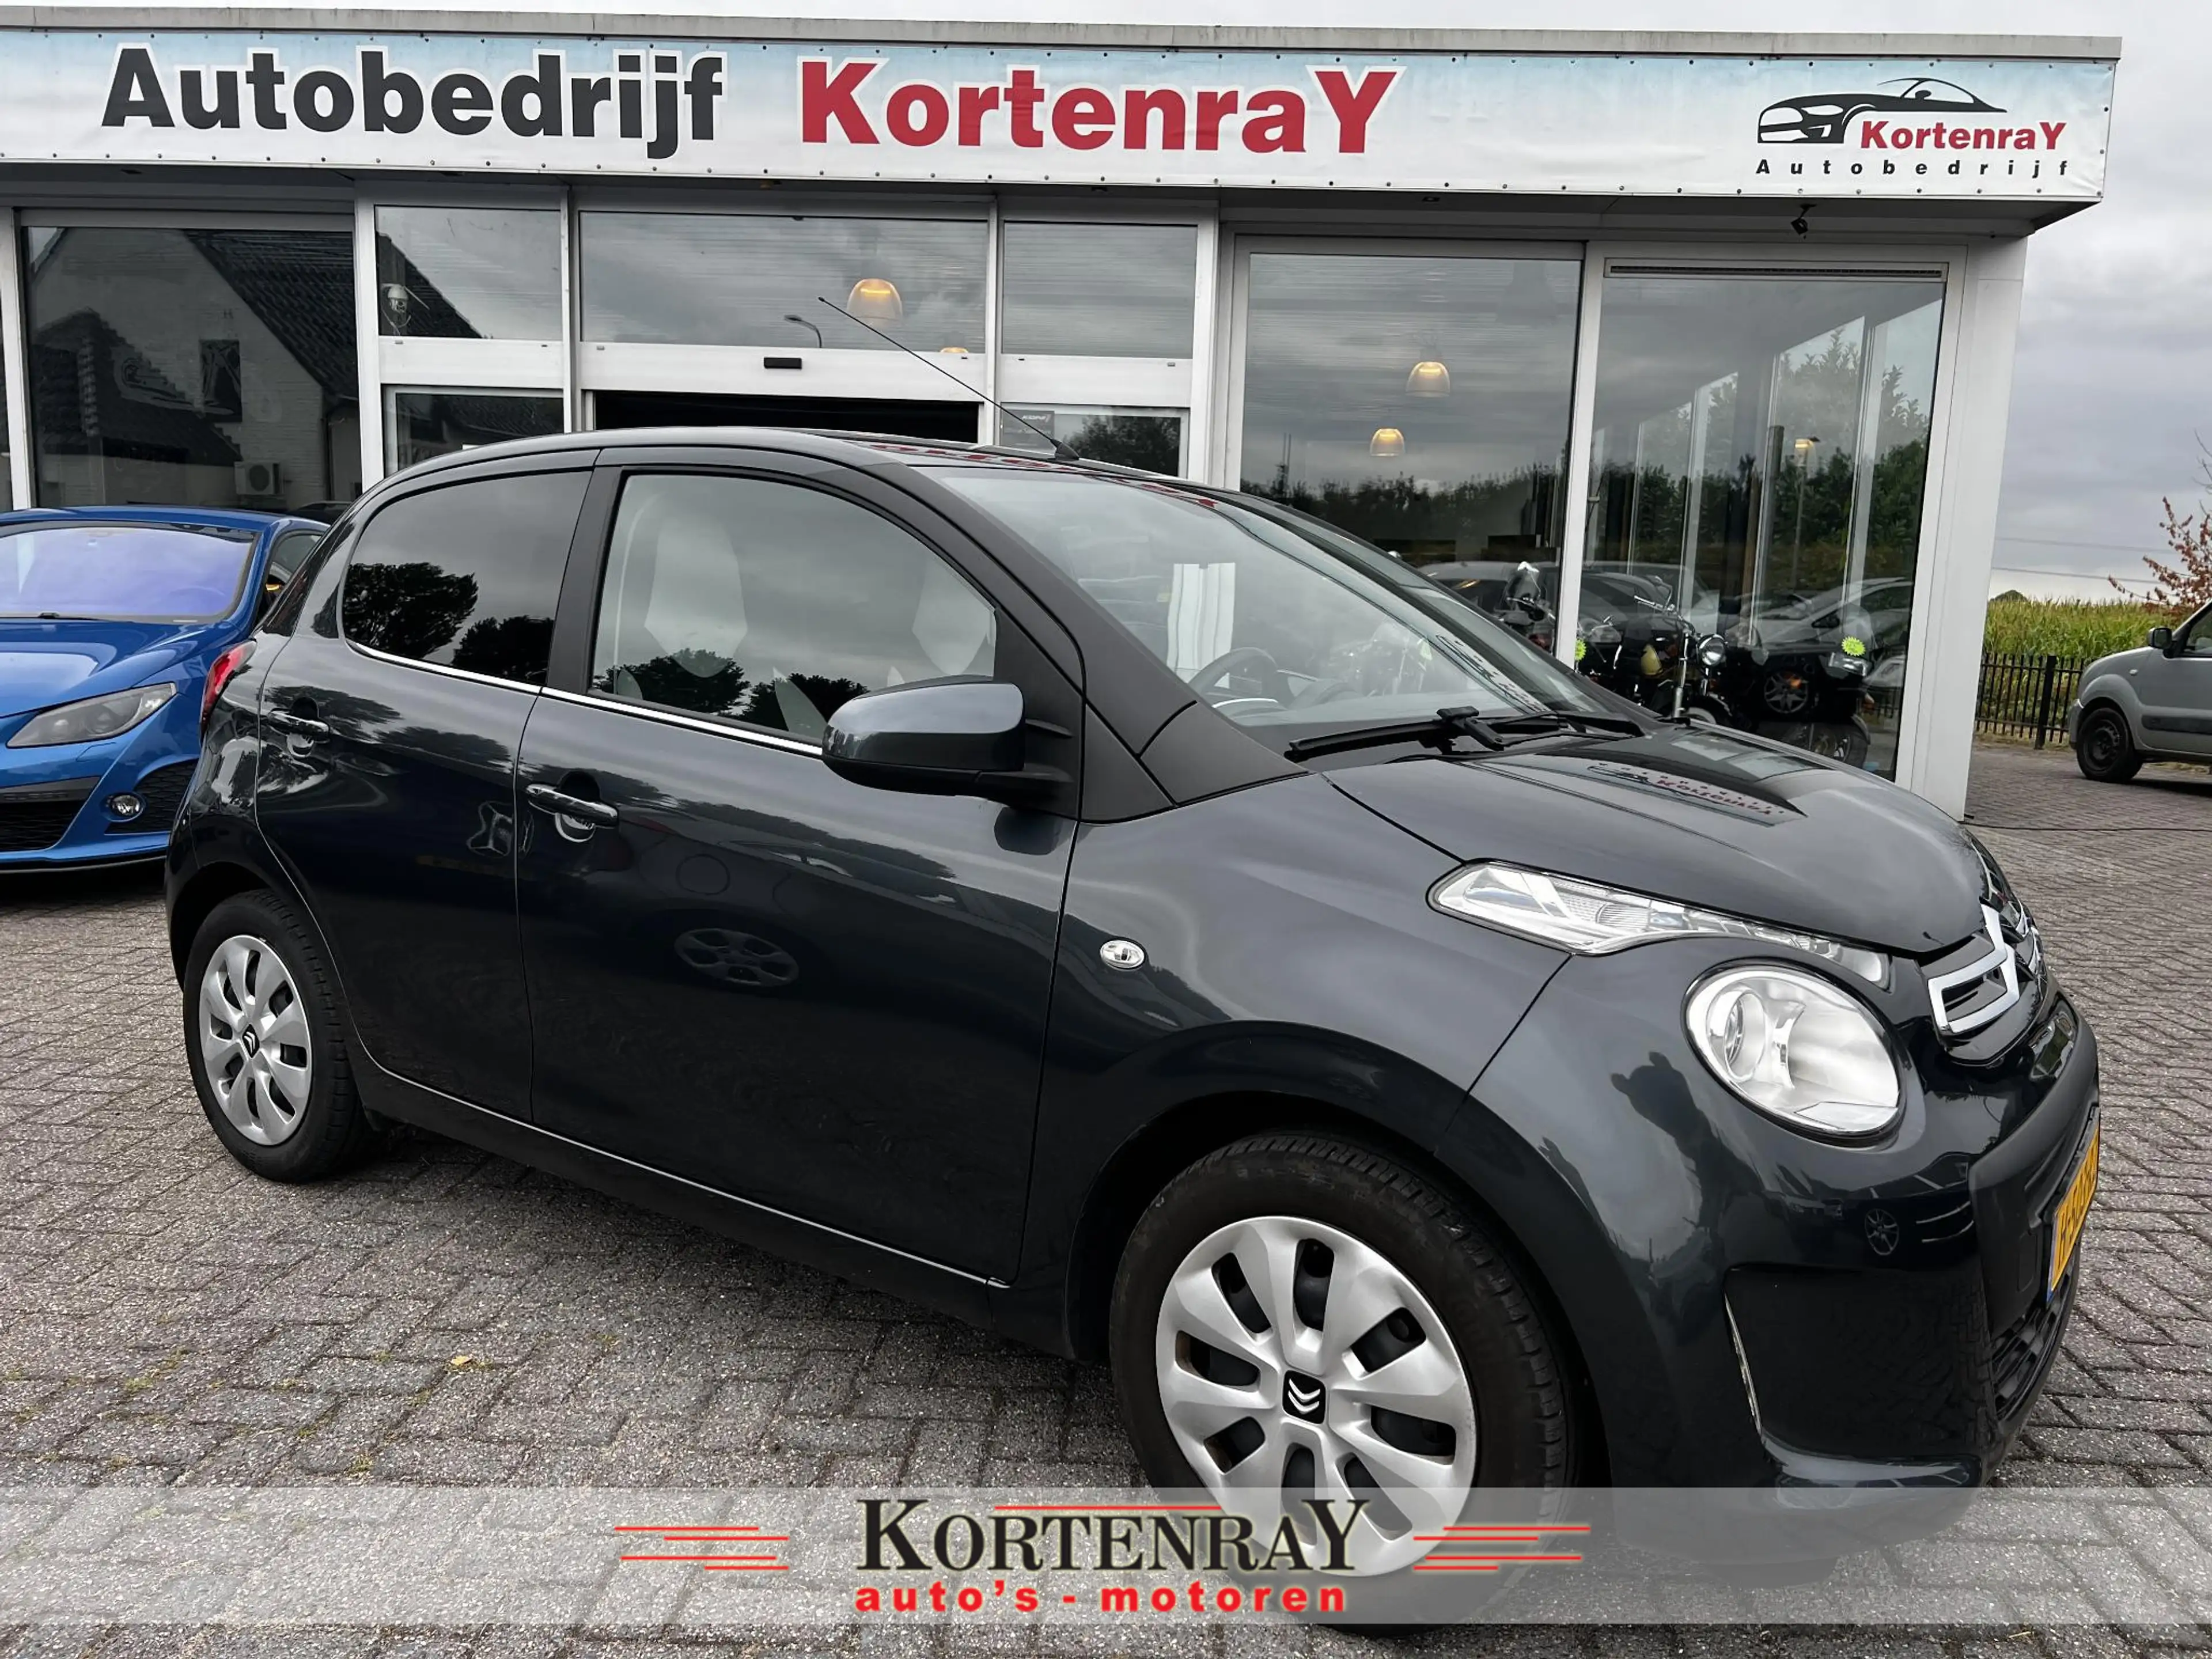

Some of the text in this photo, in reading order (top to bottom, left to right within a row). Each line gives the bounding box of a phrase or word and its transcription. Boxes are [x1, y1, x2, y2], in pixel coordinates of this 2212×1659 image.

[102, 48, 1396, 159] Autobedrijf KortenraY
[1861, 121, 2066, 150] KortenraY
[1756, 159, 2067, 178] Autobedrijf
